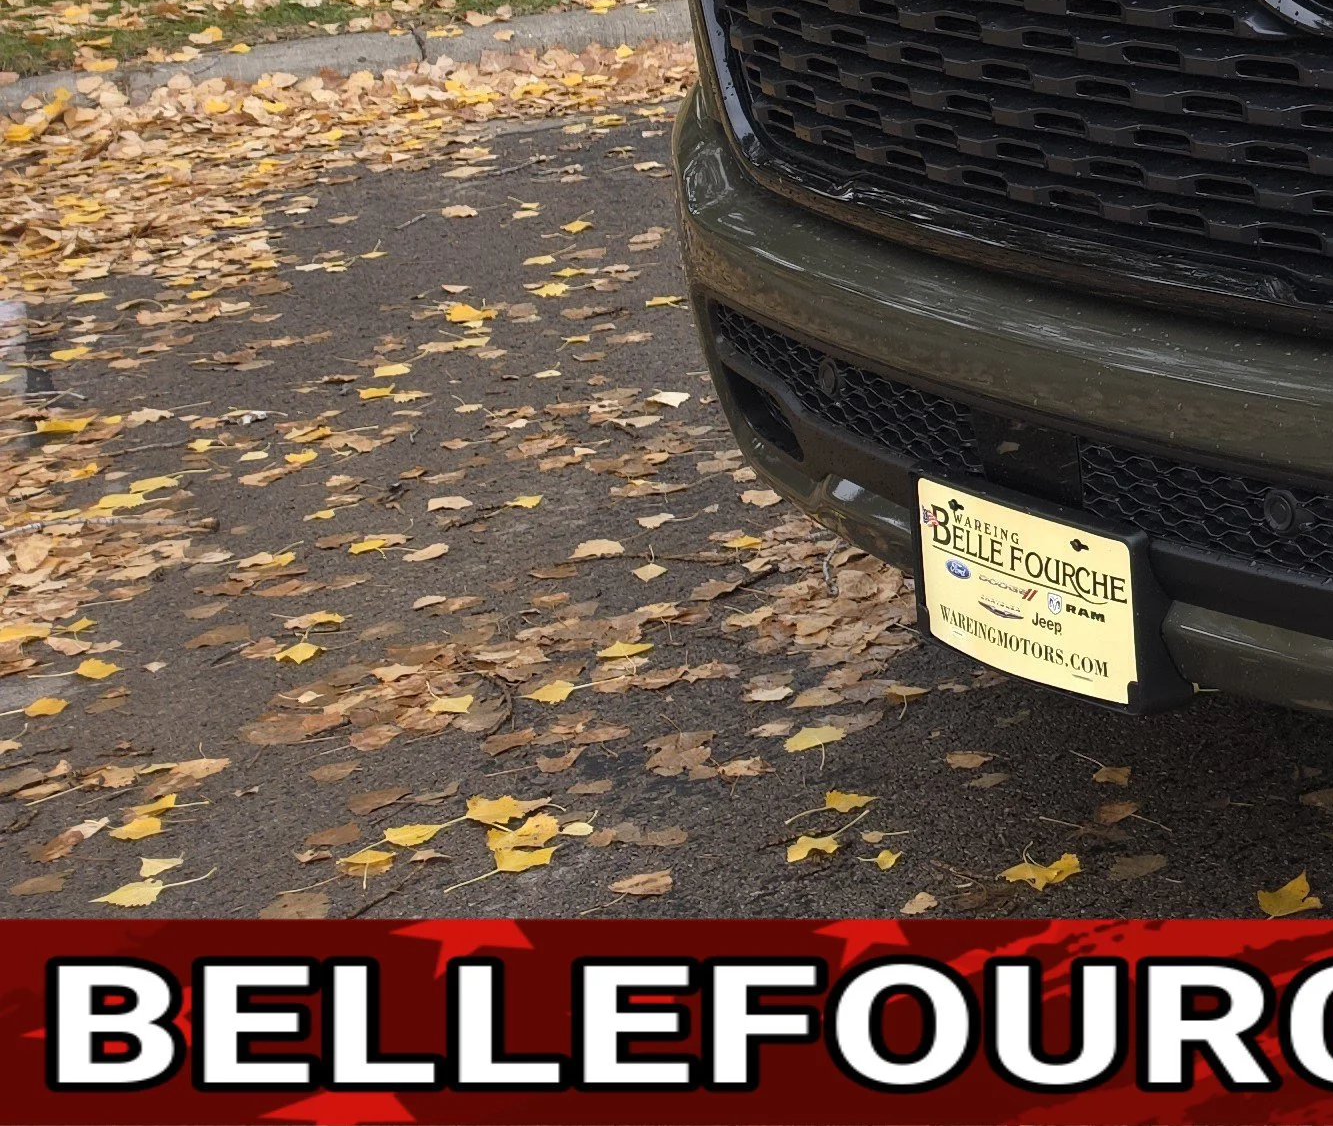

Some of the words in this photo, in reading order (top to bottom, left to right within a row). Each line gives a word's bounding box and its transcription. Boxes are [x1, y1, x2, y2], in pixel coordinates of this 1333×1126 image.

[953, 512, 1020, 545] WAREING
[930, 504, 1004, 568] BELLE
[1009, 547, 1128, 605] FOURCHE
[1031, 611, 1063, 636] Jeep
[1065, 603, 1106, 624] RAM
[939, 603, 1109, 678] WAREINGMOTORS.COM
